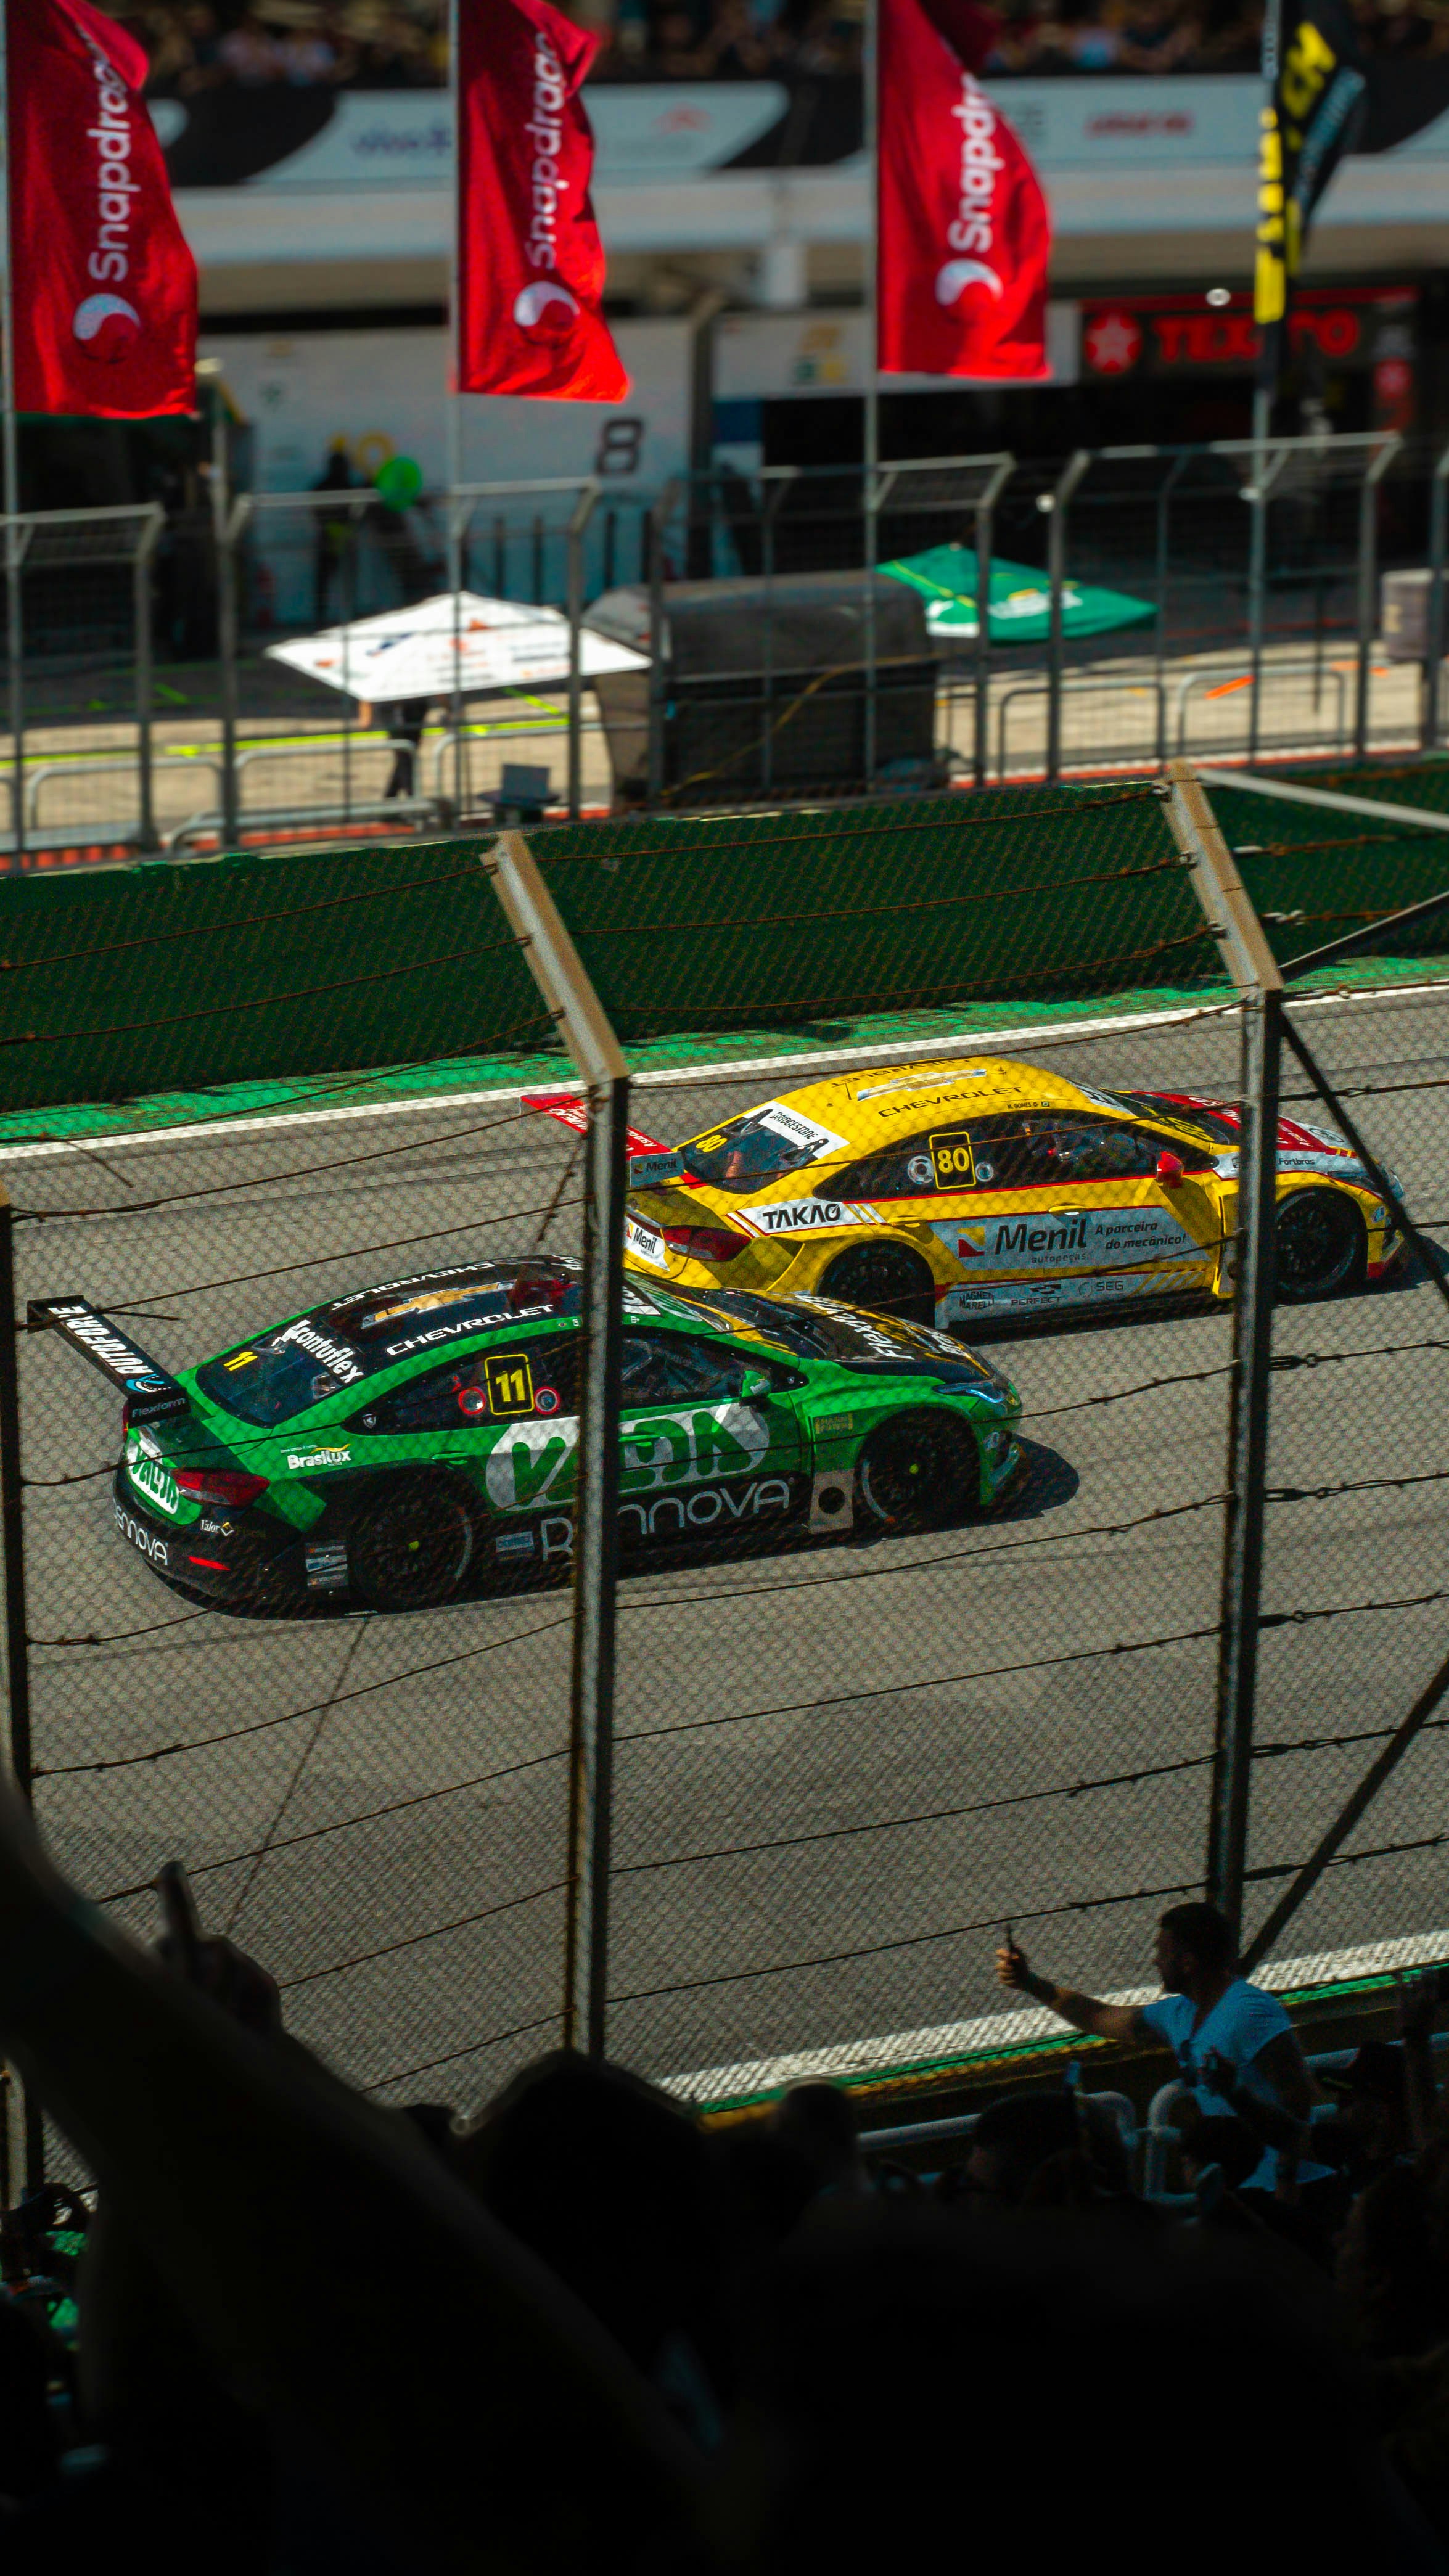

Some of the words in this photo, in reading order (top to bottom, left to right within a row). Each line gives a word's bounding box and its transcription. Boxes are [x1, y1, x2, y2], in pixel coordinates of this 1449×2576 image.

[597, 417, 644, 474] 8
[877, 1086, 1023, 1118] CHEVROLET
[770, 1110, 819, 1141] BRIDGESTONE
[696, 1134, 728, 1153] 80
[646, 1158, 677, 1172] Menil
[937, 1148, 969, 1174] 80
[763, 1202, 842, 1229] TAKAO
[995, 1218, 1086, 1255] Menil
[1095, 1223, 1105, 1236] A
[1106, 1221, 1158, 1237] parceira
[633, 1227, 657, 1254] Menil
[1106, 1238, 1121, 1250] do
[1123, 1233, 1187, 1250] mecânico!
[1031, 1252, 1088, 1265] autopeças
[332, 1262, 495, 1311] CHEVROLET
[1096, 1280, 1124, 1292] SEG
[1011, 1296, 1061, 1306] PERFECT
[385, 1304, 554, 1356] CHEVROLET
[224, 1351, 258, 1371] 11
[495, 1368, 527, 1403] 11
[131, 1397, 186, 1419] Flexform
[287, 1449, 352, 1470] Brasilux
[201, 1519, 221, 1533] Valor
